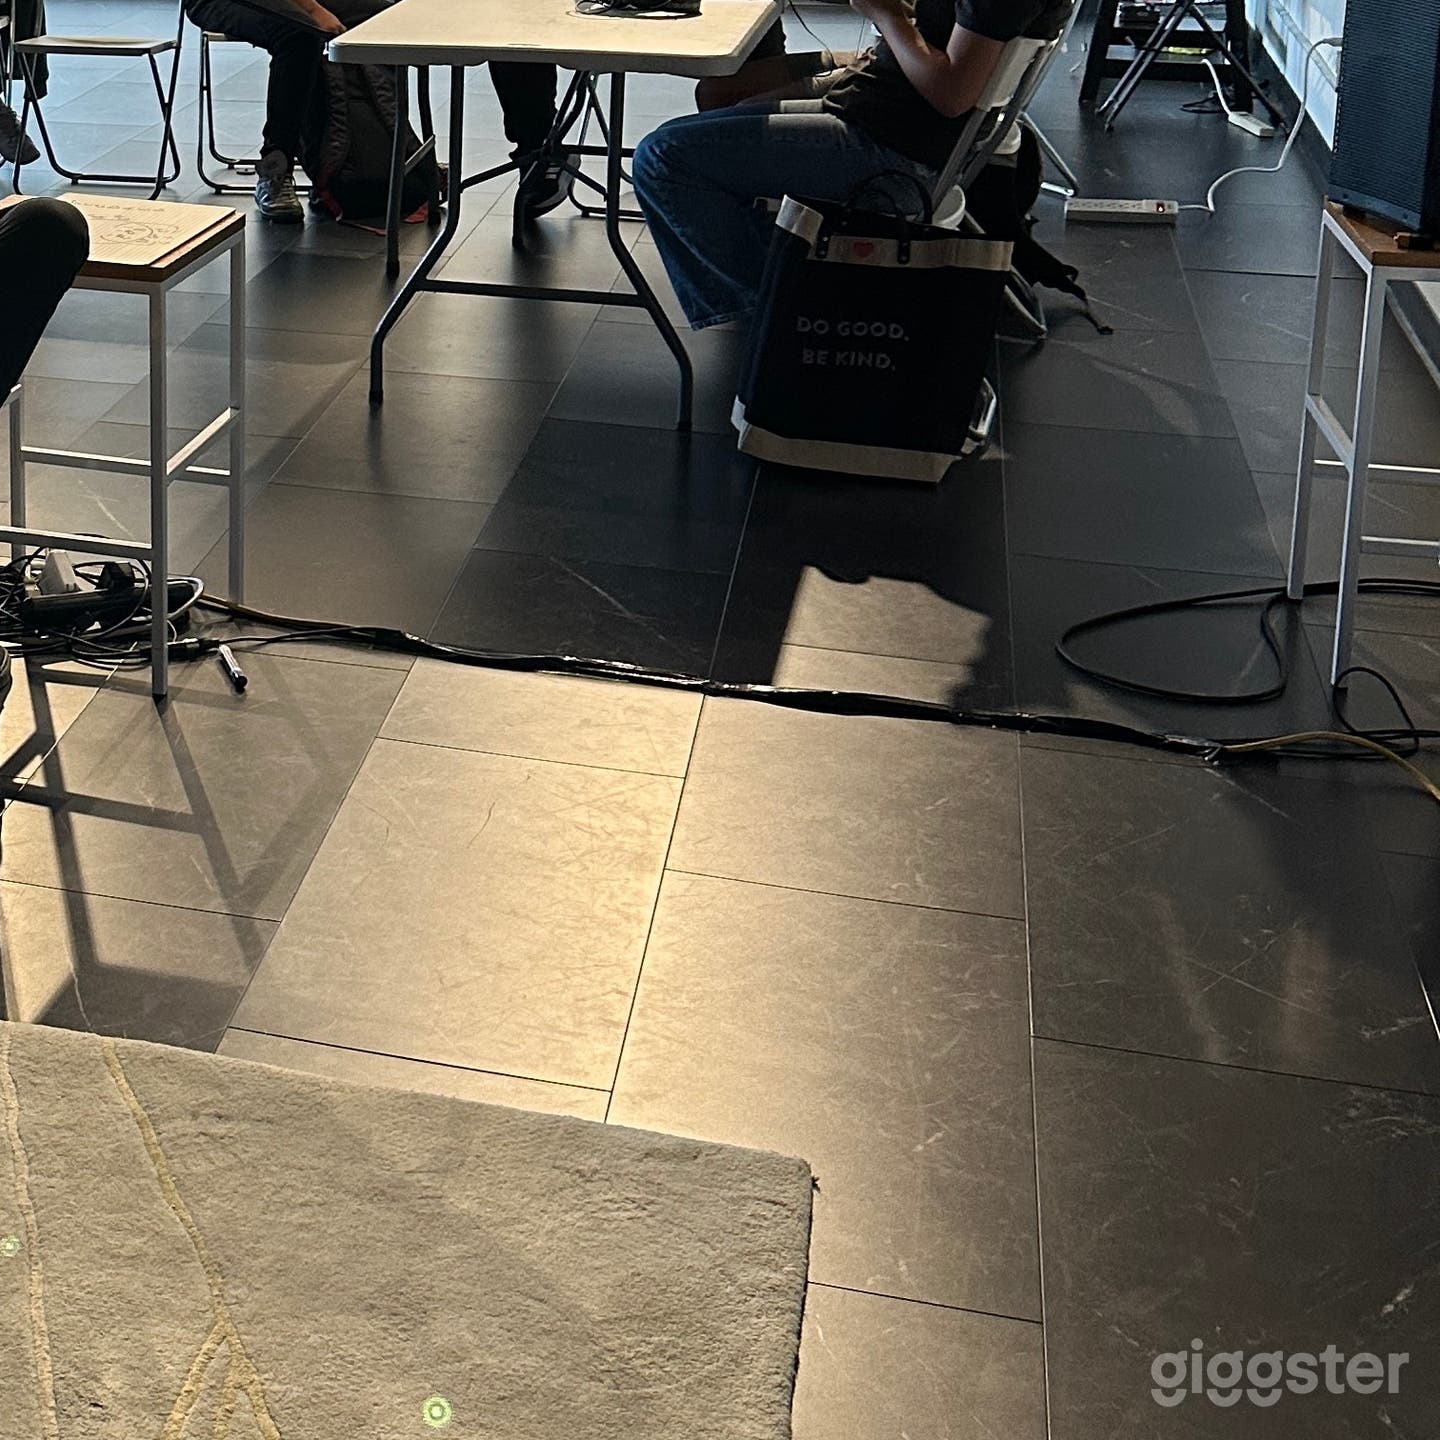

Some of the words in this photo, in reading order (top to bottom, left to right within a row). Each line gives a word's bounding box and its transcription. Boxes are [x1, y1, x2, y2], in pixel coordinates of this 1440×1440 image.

[797, 315, 830, 335] DO
[837, 320, 910, 342] GOOD.
[802, 348, 829, 366] BE
